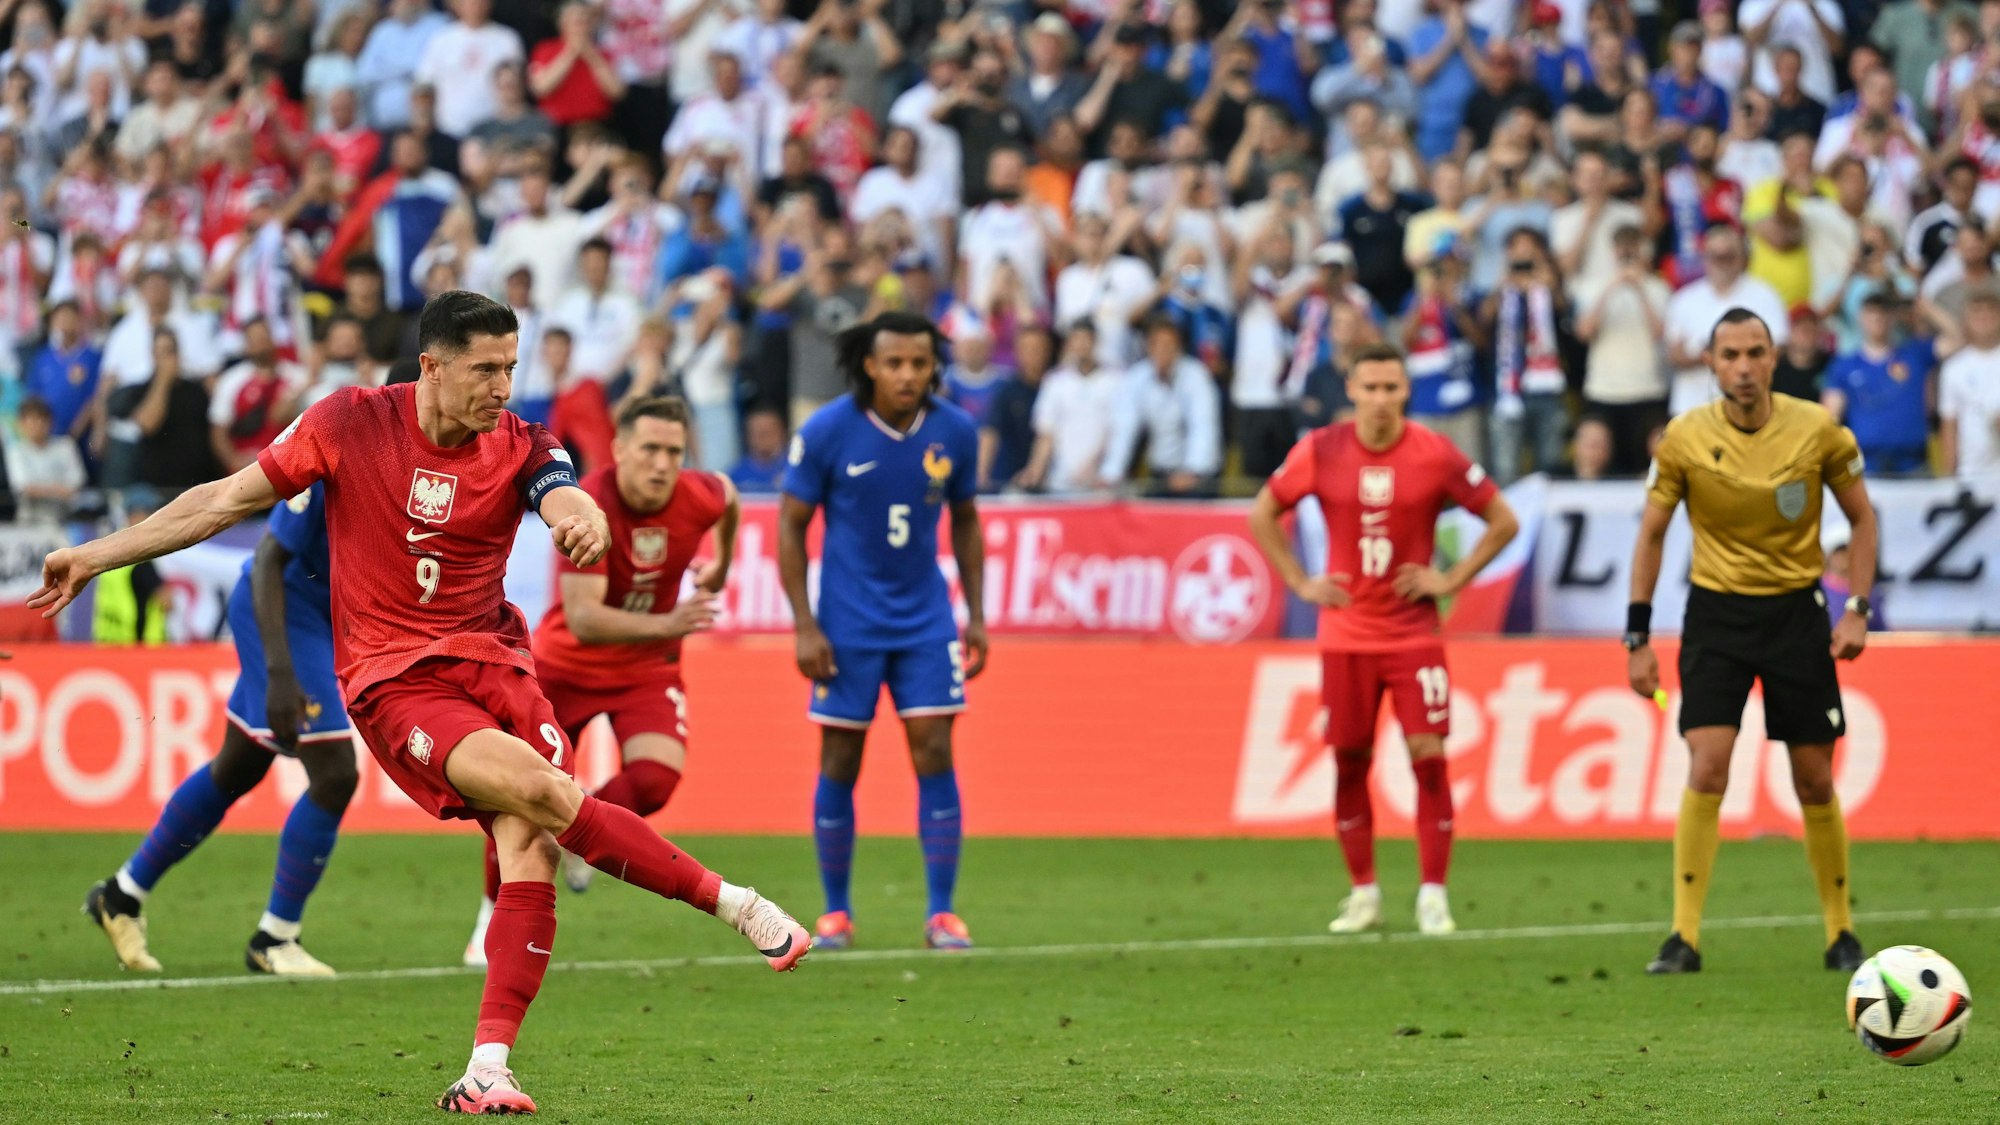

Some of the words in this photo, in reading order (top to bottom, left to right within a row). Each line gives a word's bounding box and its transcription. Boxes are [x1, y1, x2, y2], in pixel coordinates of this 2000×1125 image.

[536, 472, 571, 490] RESPECT
[886, 504, 911, 548] 5
[1358, 535, 1394, 577] 19
[416, 557, 441, 604] 9
[947, 640, 966, 683] 5
[1416, 665, 1449, 706] 19
[539, 722, 564, 766] 9
